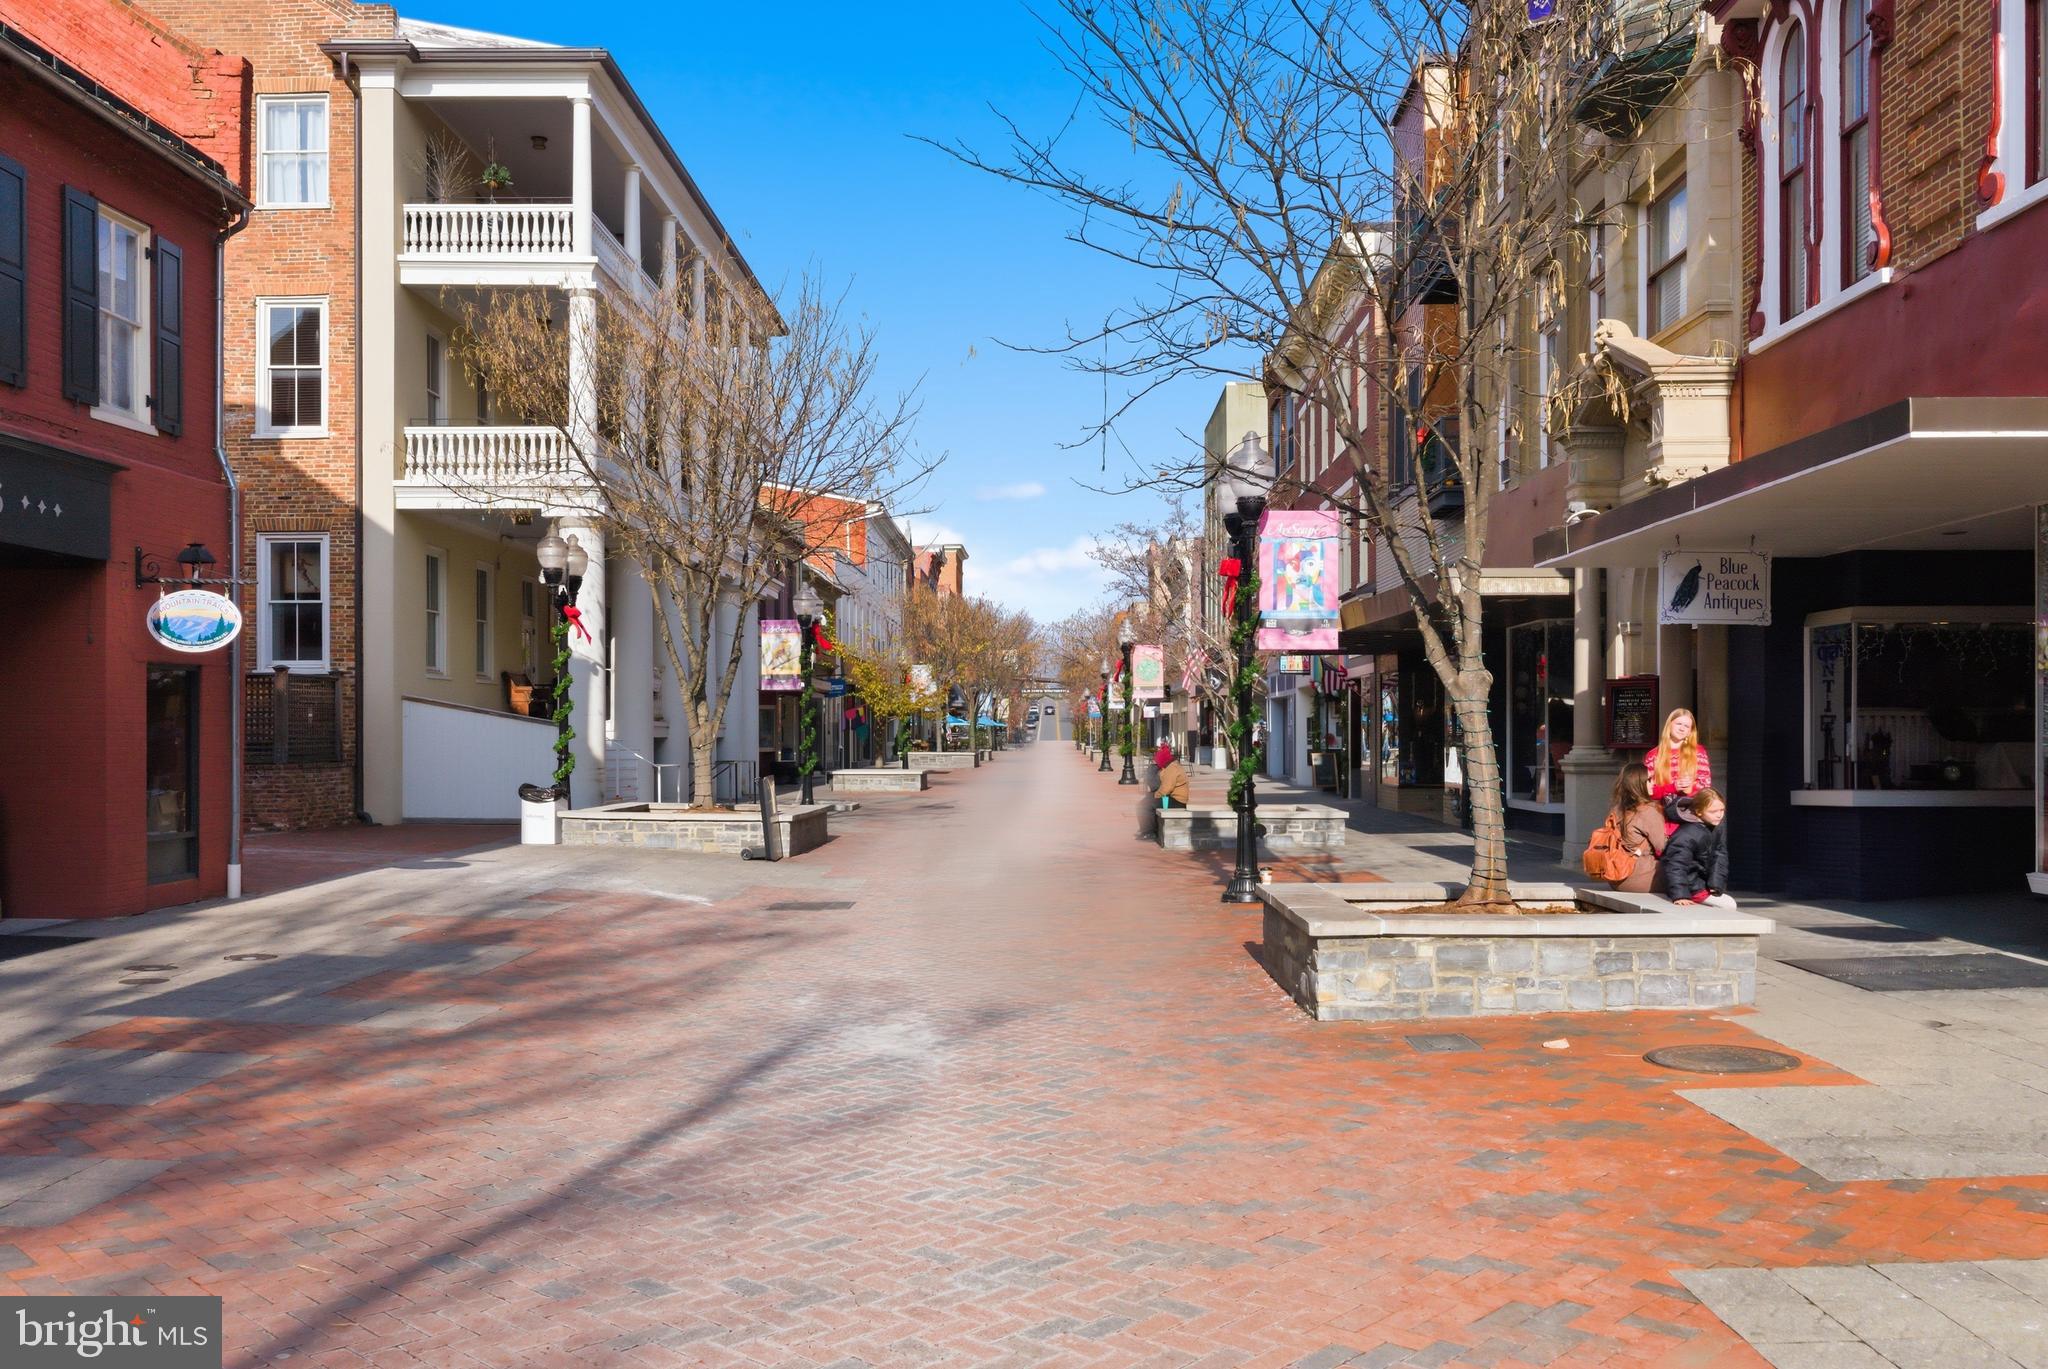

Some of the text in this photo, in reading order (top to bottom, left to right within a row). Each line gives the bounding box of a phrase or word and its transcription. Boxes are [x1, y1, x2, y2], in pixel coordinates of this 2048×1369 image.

[1720, 557, 1748, 575] Blue
[1707, 573, 1760, 591] Peacock
[159, 598, 230, 616] MOUNTAIN TRAILS
[1704, 592, 1764, 615] Antiques
